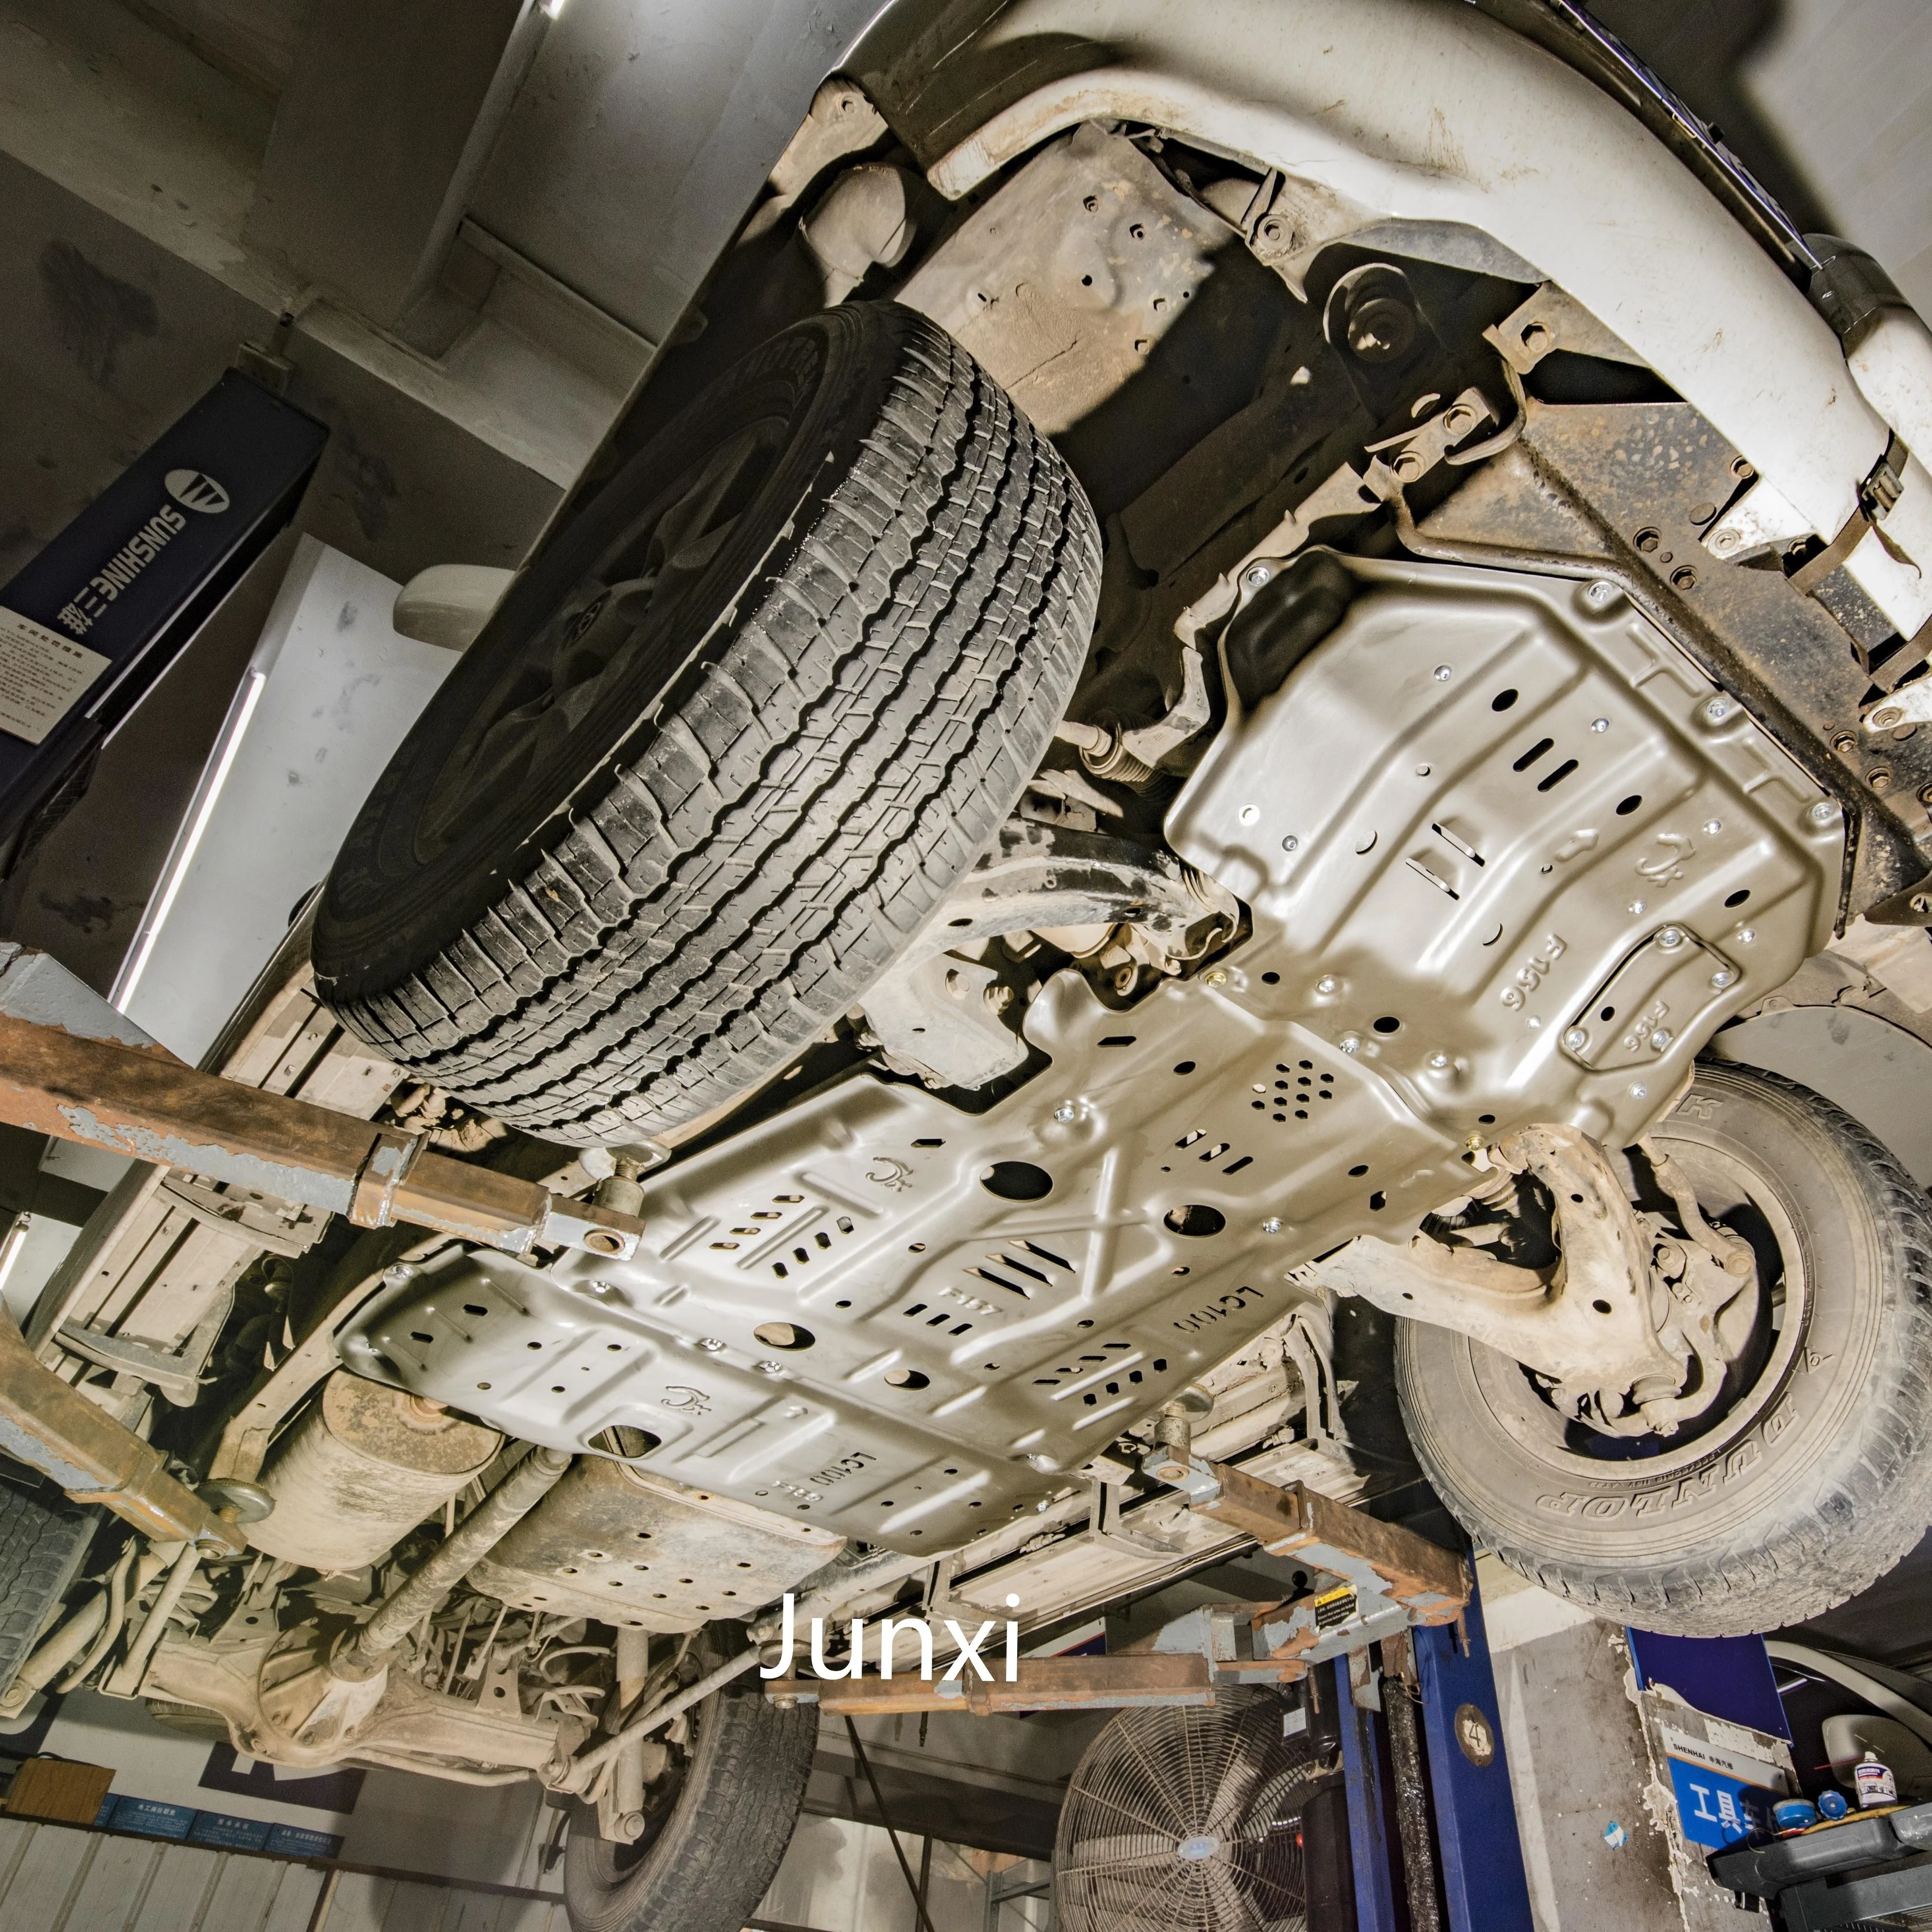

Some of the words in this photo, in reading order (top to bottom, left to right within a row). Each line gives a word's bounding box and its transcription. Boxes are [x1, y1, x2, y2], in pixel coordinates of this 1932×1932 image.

[1499, 933, 1567, 1011] F156
[1536, 1392, 1801, 1520] DUNLOP
[1469, 1723, 1481, 1747] 4
[1673, 1743, 1705, 1760] SHENHAI
